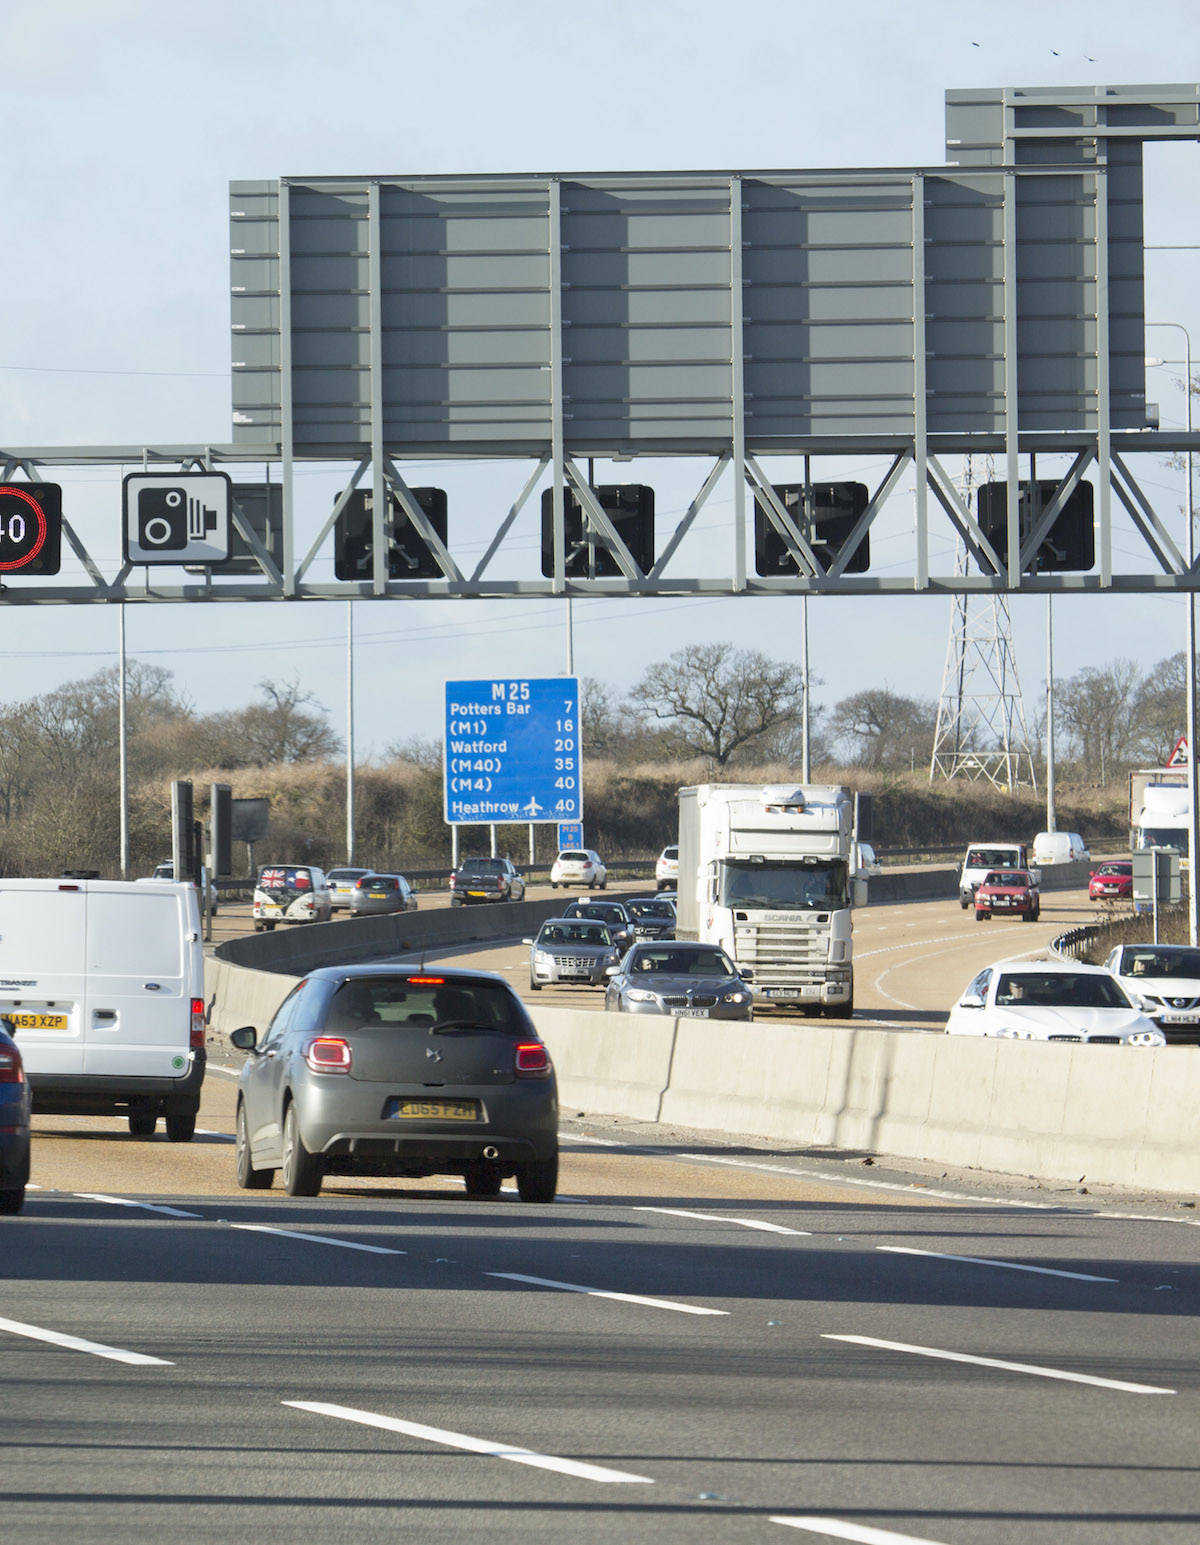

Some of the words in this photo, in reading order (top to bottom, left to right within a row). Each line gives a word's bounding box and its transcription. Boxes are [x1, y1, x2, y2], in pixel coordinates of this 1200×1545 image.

[450, 702, 502, 716] Potters
[506, 701, 531, 715] Bar
[564, 700, 573, 713] 7
[450, 719, 487, 736] (M1)
[556, 719, 574, 732] 16
[450, 739, 507, 754] Watford
[554, 738, 574, 752] 20
[451, 757, 502, 774] (M40)
[554, 757, 574, 771] 35
[451, 776, 492, 793] (M4)
[554, 776, 575, 790] 40
[452, 800, 519, 814] Heathrow
[555, 798, 575, 812] 40
[764, 914, 802, 922] SCANIA
[5, 1014, 37, 1027] NA63
[39, 1015, 63, 1028] XZP
